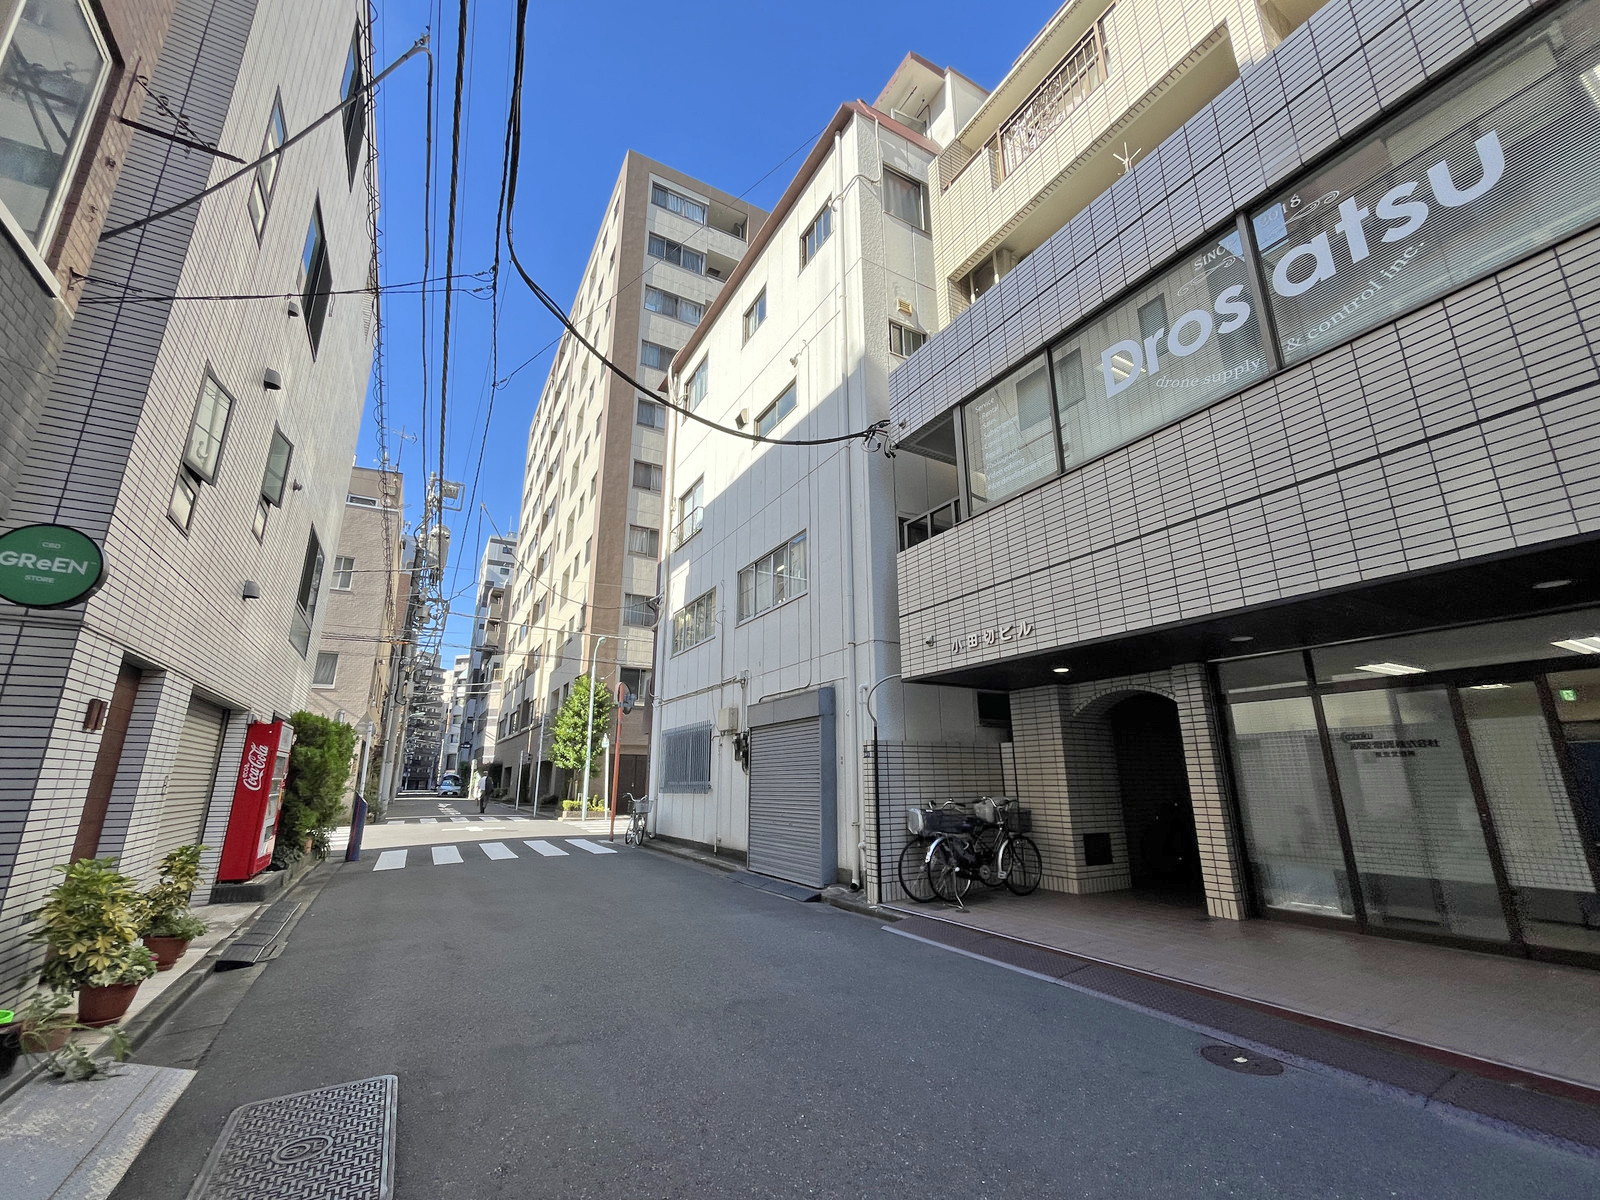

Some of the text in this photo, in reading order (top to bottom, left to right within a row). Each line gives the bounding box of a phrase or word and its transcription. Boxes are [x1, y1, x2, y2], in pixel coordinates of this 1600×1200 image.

[1156, 242, 1425, 390] drone supply & control inc.
[975, 397, 994, 413] Service
[982, 403, 999, 418] Rental
[0, 551, 88, 575] GReEN
[25, 574, 55, 584] STORE
[952, 620, 1034, 653] 小田切ビル
